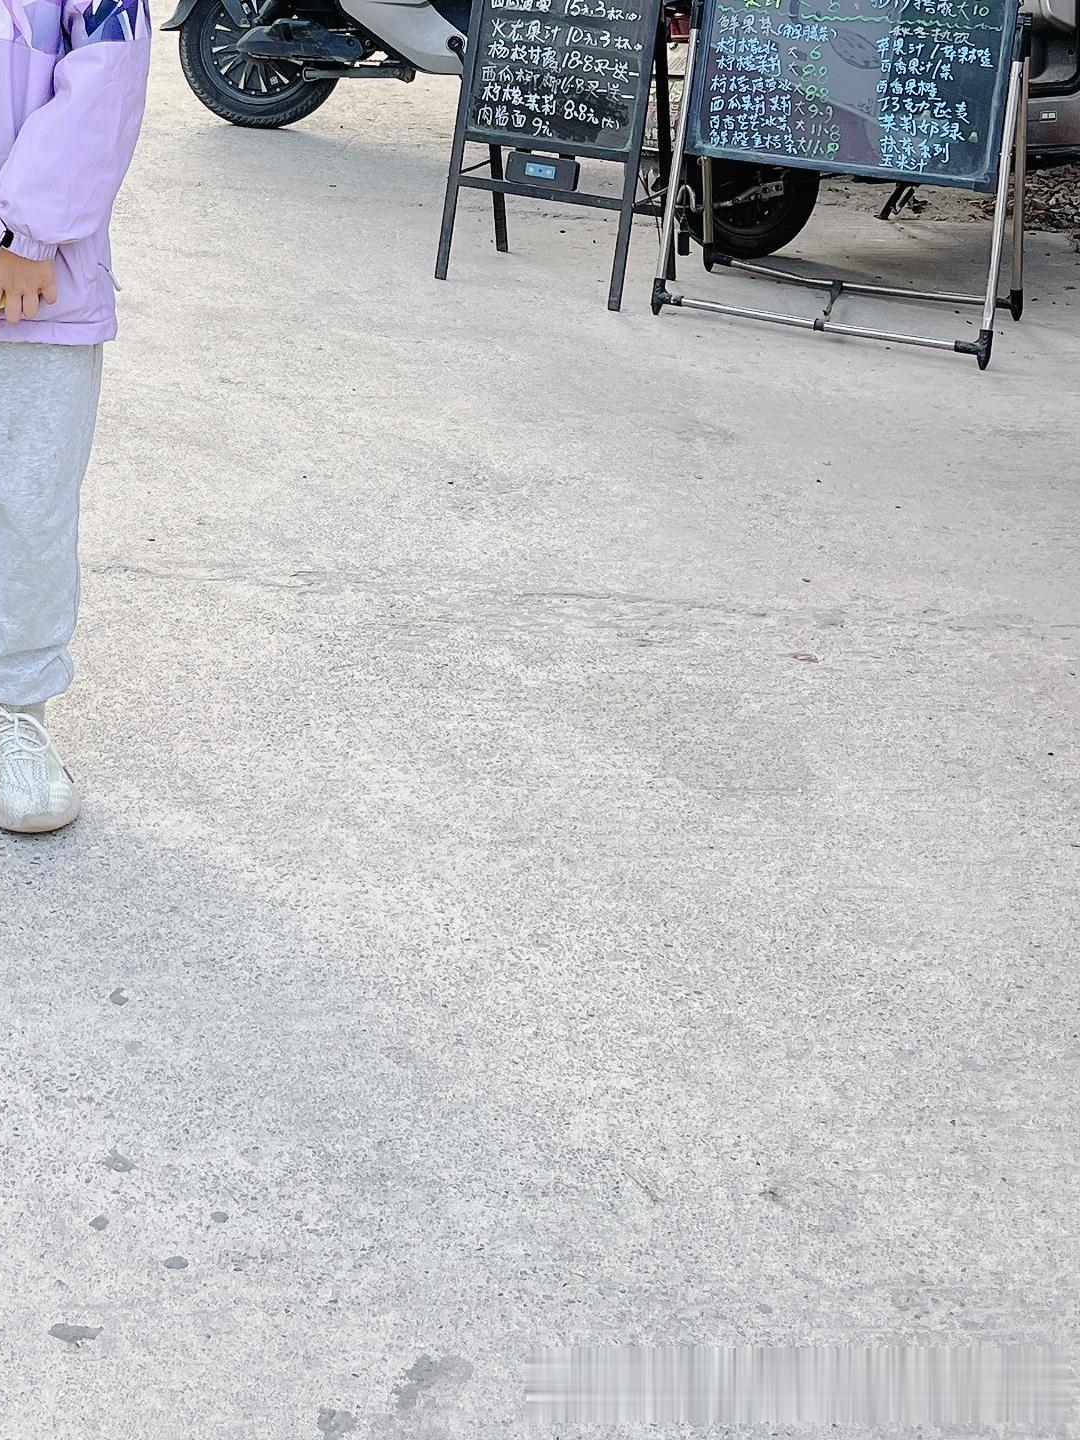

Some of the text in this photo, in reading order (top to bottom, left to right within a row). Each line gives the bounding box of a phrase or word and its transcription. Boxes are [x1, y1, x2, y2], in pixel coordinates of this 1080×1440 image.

[972, 4, 990, 17] 10
[809, 45, 822, 60] 6
[482, 82, 556, 116] 柠檬茉莉
